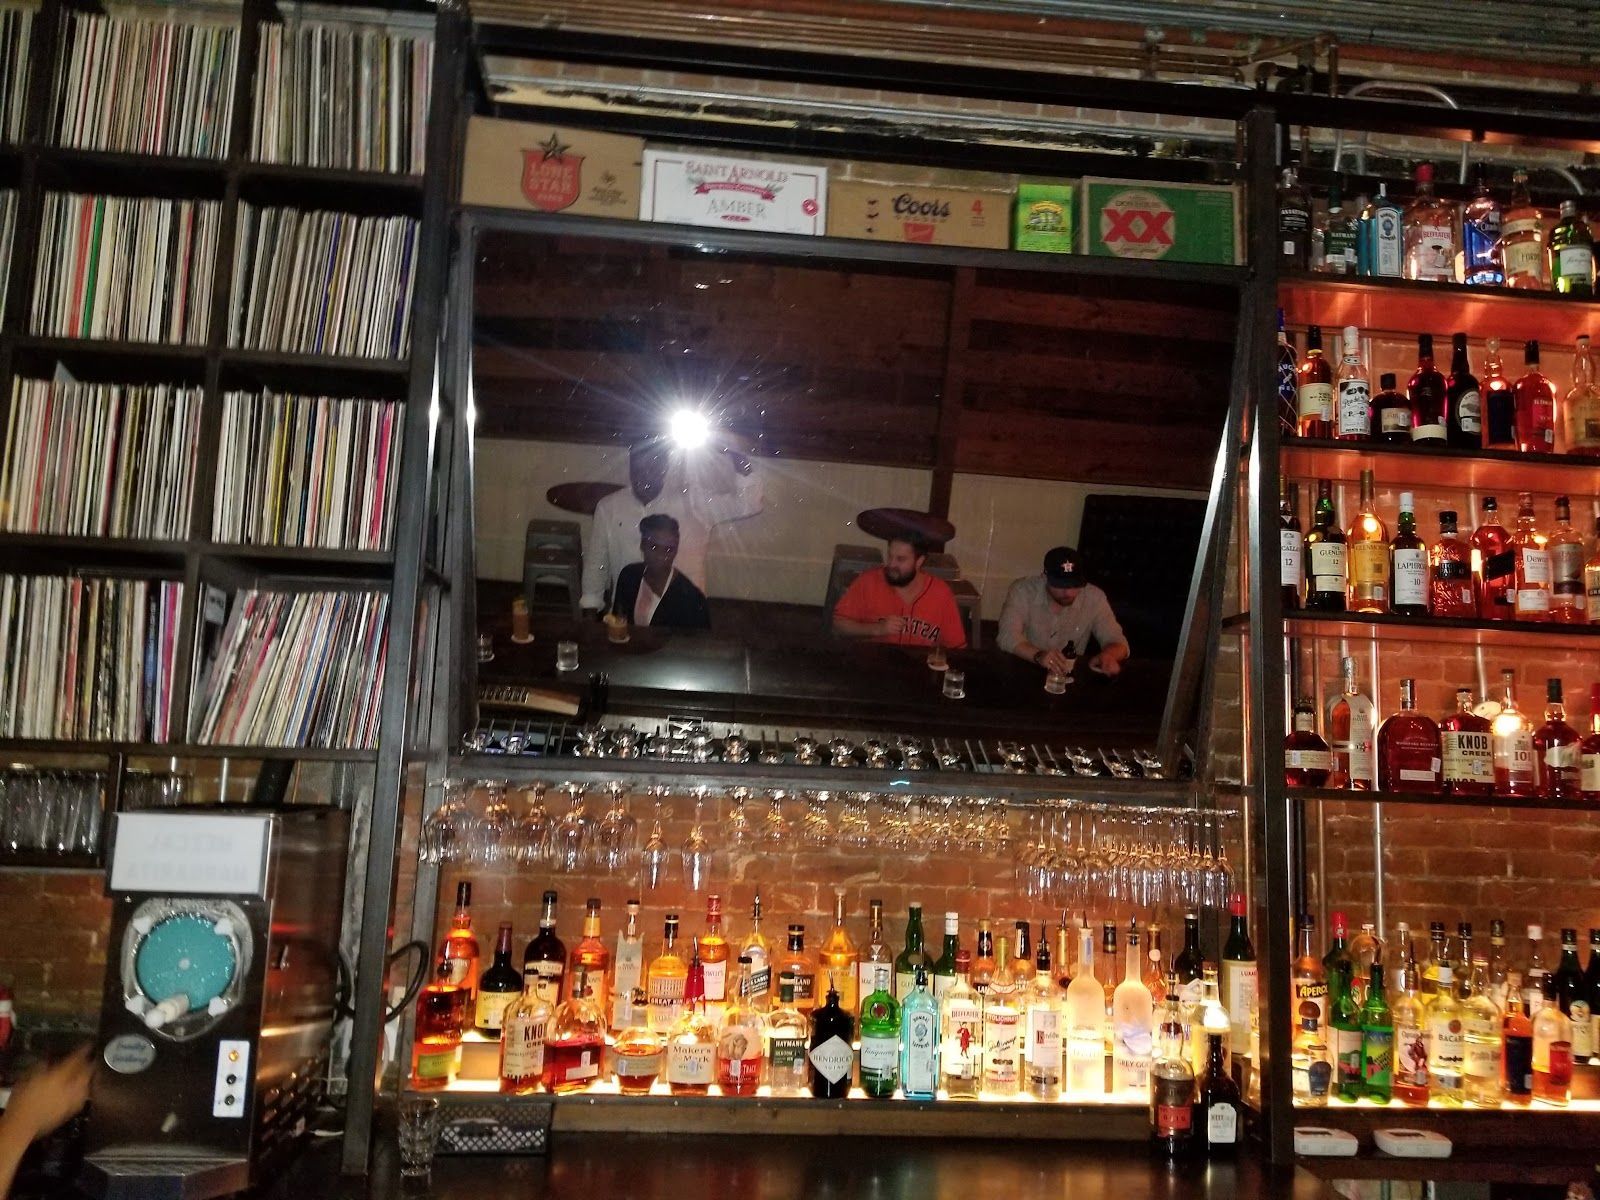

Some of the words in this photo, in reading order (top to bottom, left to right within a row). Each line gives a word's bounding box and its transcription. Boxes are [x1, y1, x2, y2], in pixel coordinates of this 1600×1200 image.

[685, 160, 727, 177] SAINT
[727, 163, 788, 183] ARNOLD
[707, 200, 768, 218] AMBER
[892, 193, 951, 217] Coors
[971, 199, 983, 215] 4
[1103, 208, 1175, 245] XX
[1423, 231, 1451, 239] BEEFEATER
[1320, 549, 1344, 557] GLENLI
[1285, 558, 1293, 566] 12
[1413, 578, 1421, 586] 10
[1458, 735, 1488, 750] KNOB
[951, 1010, 979, 1018] BEEFEATER
[673, 1046, 711, 1054] Maker's
[864, 1047, 895, 1057] Tanqueray
[683, 1055, 709, 1063] Mark
